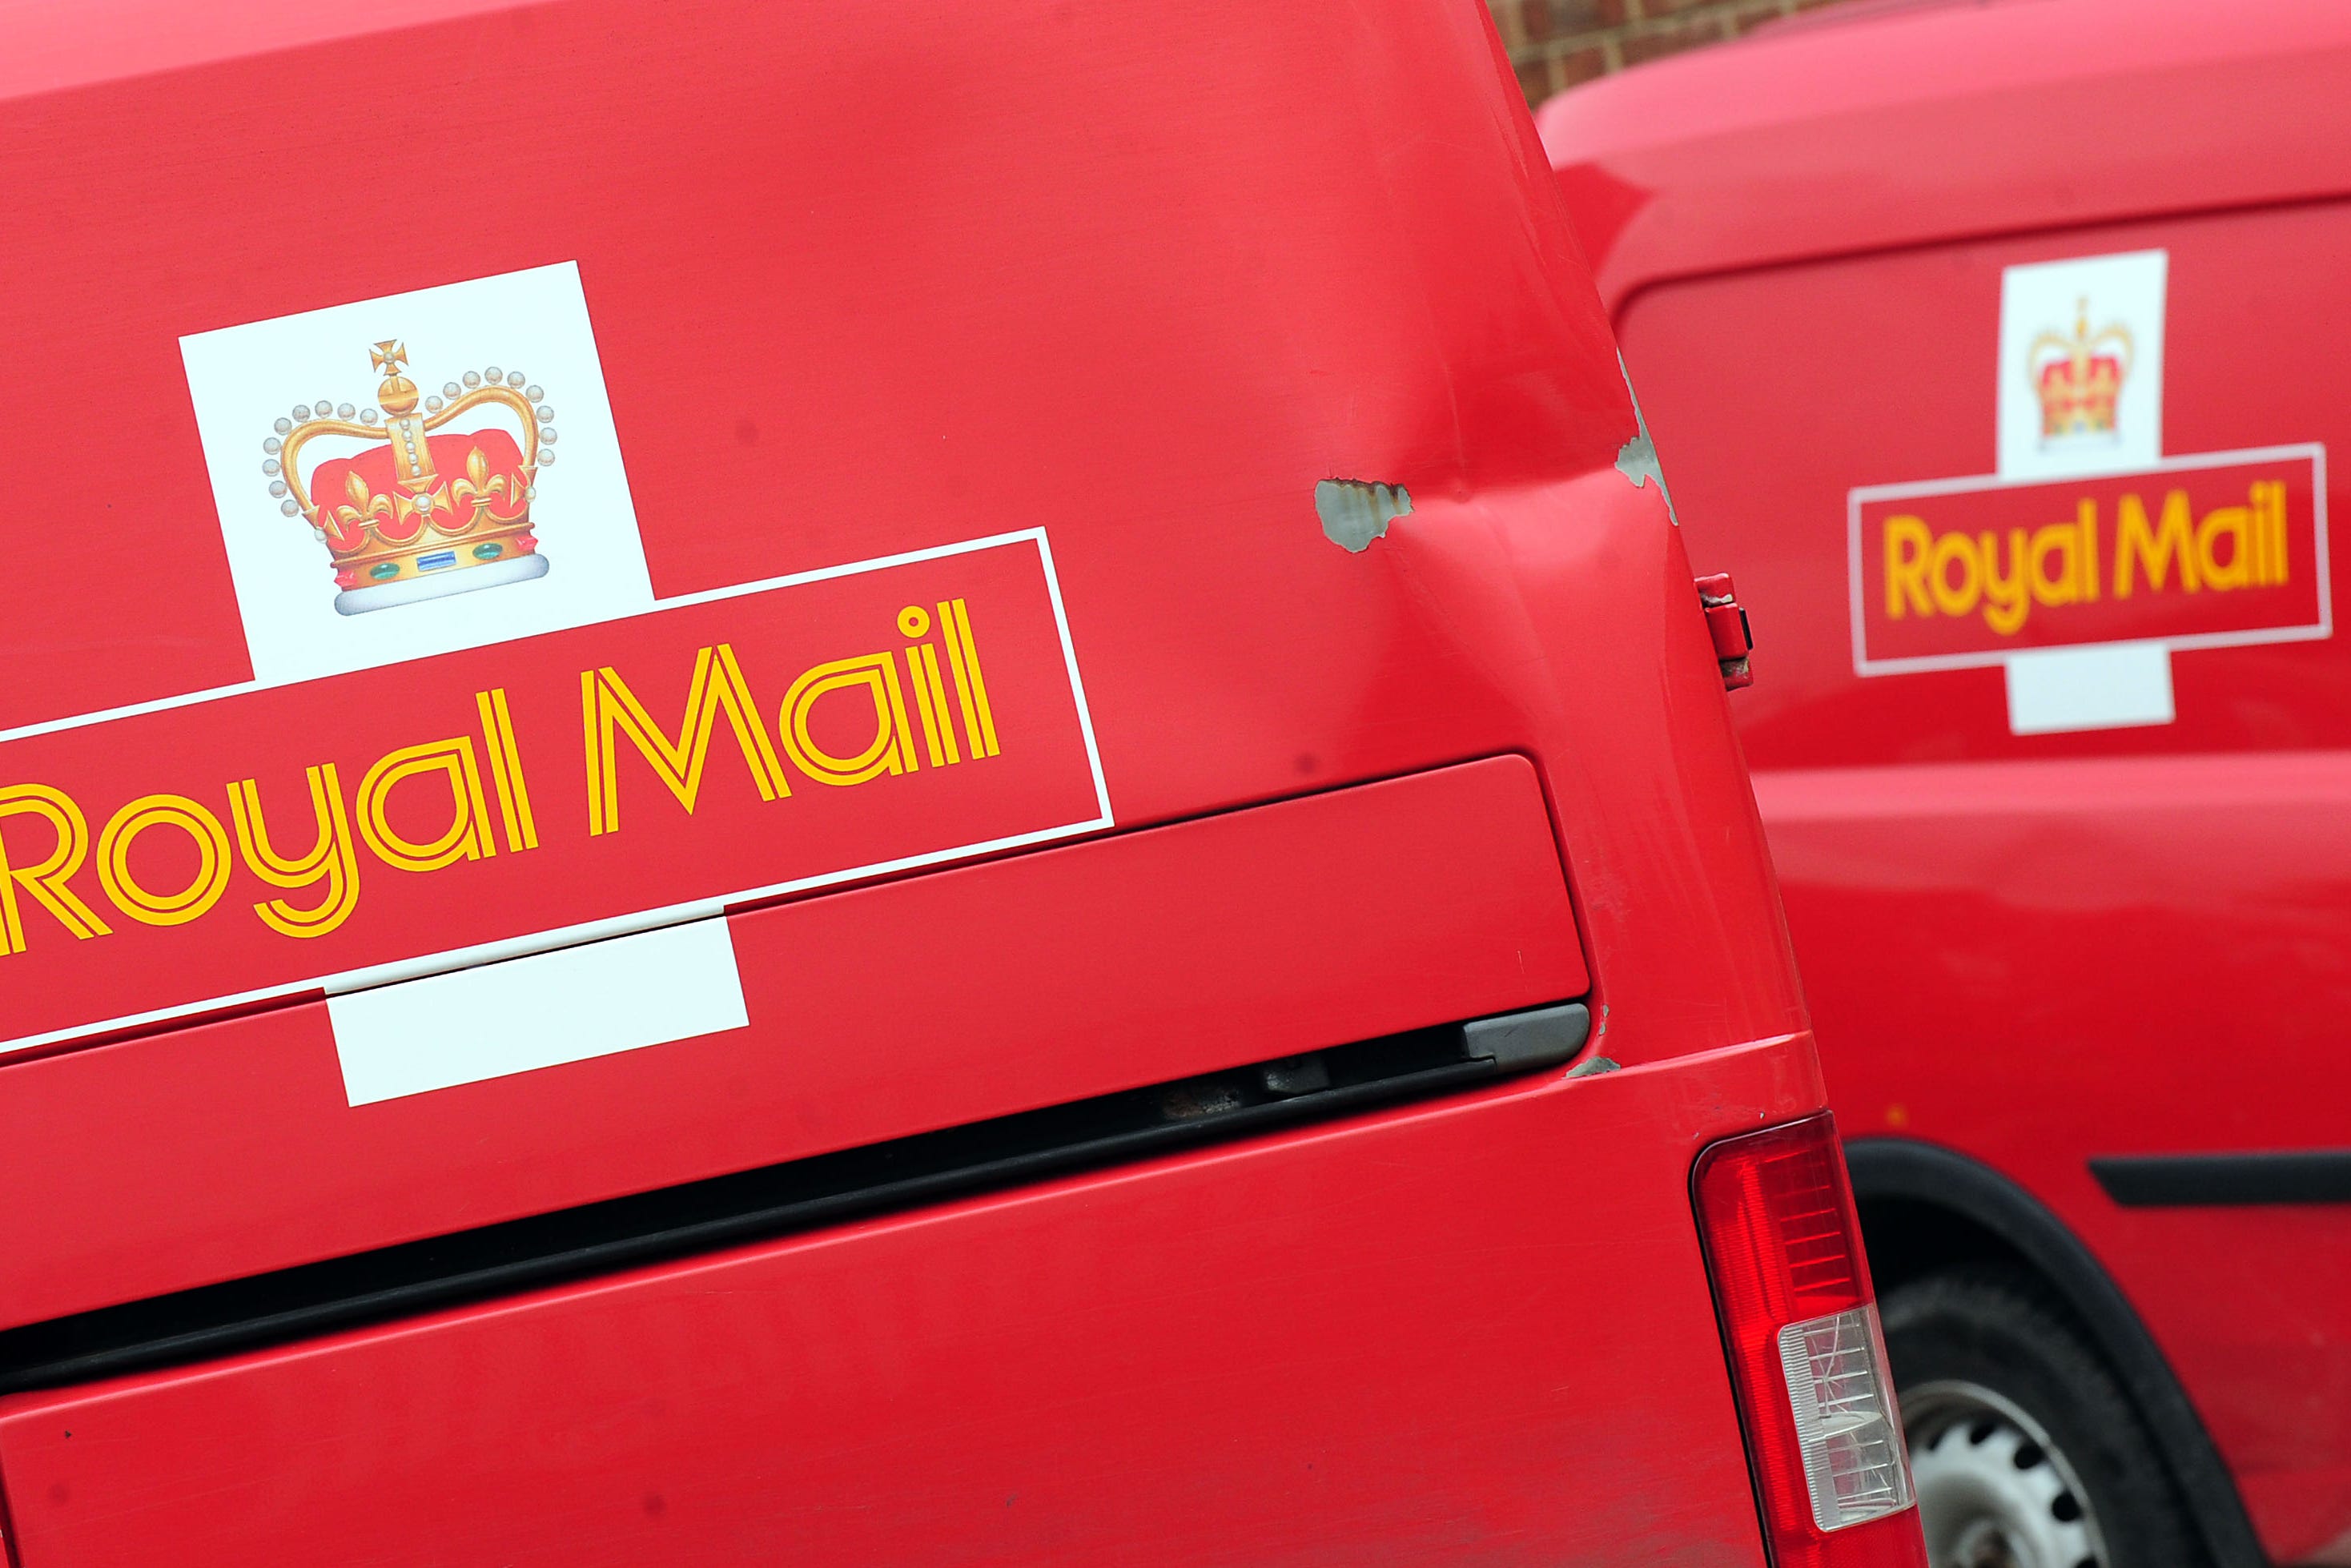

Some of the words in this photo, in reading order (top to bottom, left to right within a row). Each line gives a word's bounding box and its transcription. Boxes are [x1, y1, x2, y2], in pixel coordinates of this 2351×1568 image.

[1883, 497, 2100, 635] Royal
[2113, 480, 2289, 600] Mail
[0, 687, 540, 957] Royal
[581, 597, 1002, 838] Mail
